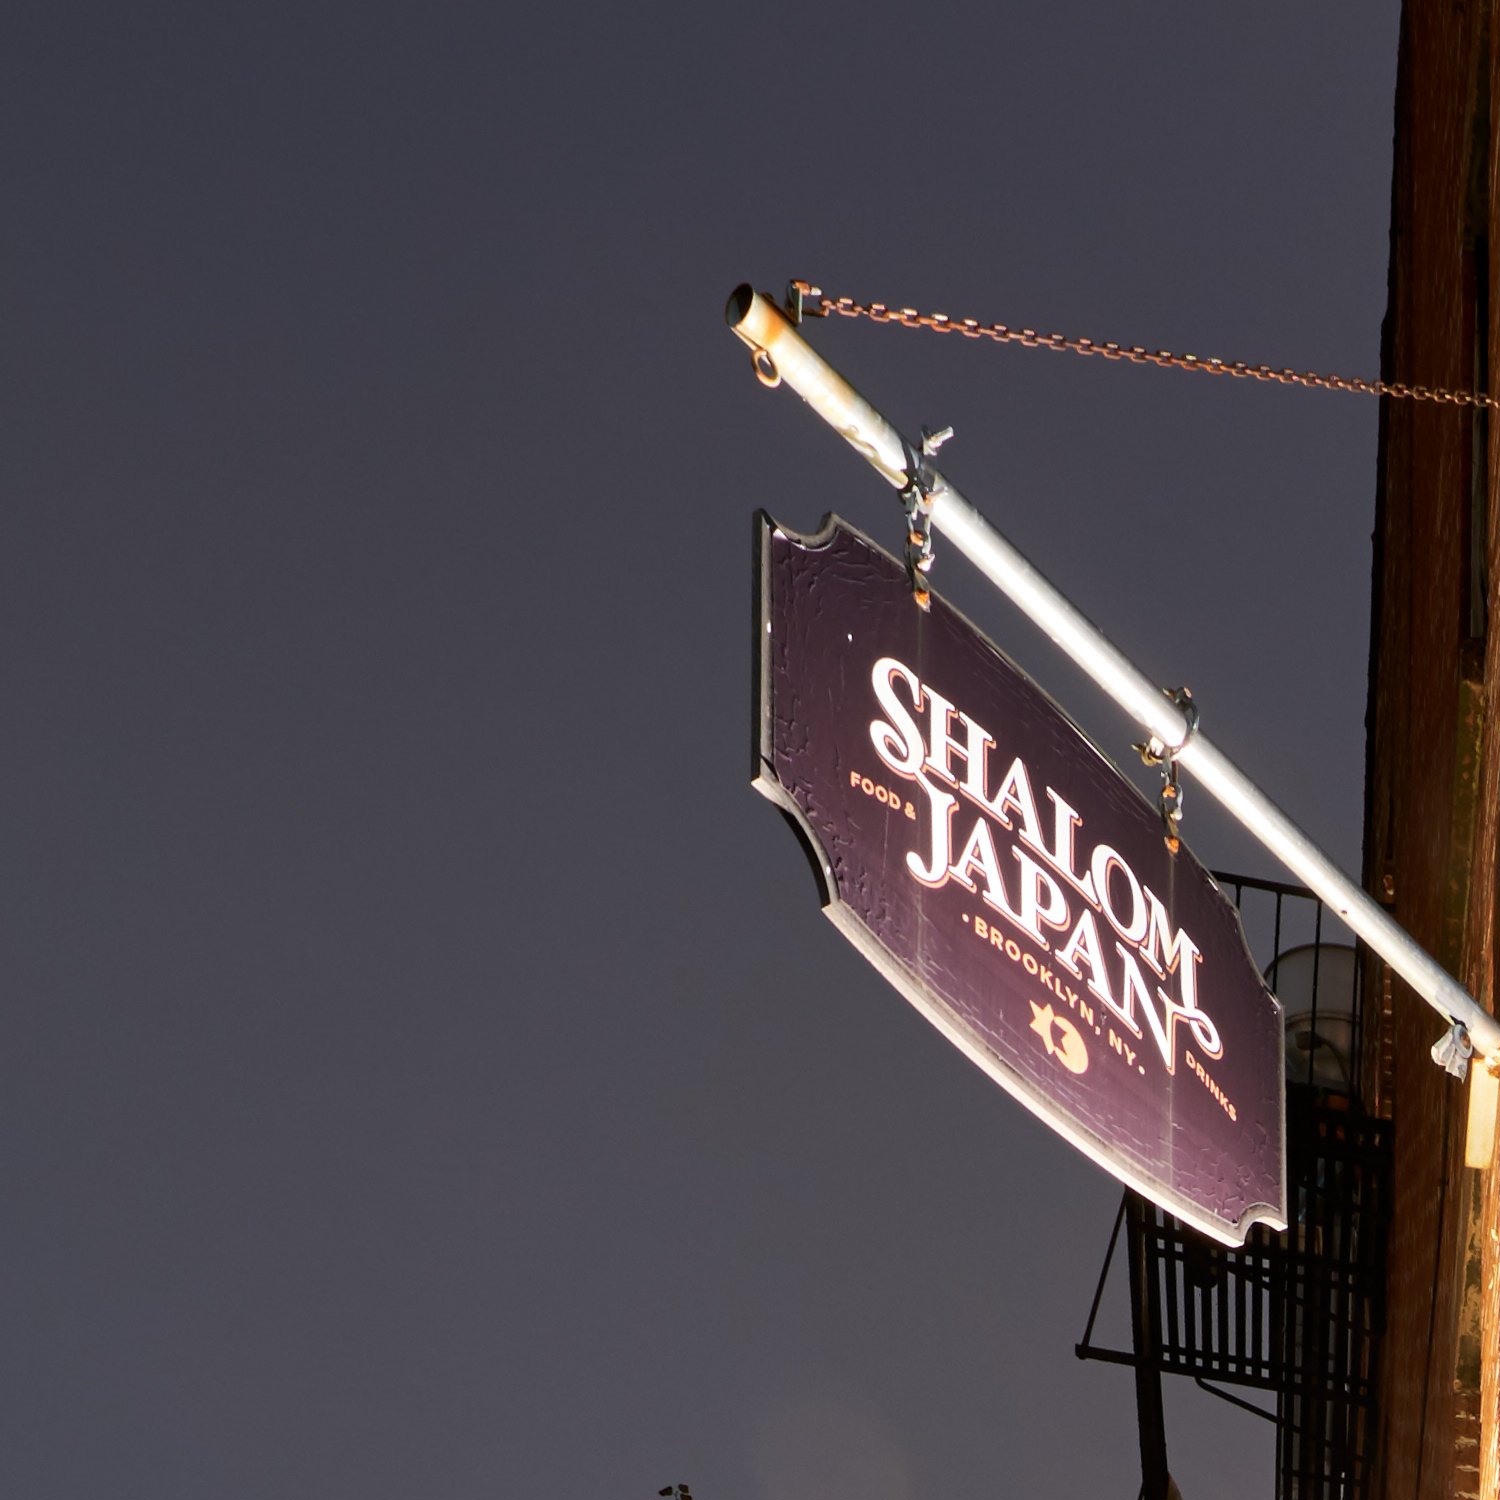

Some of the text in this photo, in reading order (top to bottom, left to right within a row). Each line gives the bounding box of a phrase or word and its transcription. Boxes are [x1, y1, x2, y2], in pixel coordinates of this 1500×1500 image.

[850, 771, 917, 821] FOOD &
[869, 656, 1224, 1061] SHALOM
[905, 772, 1186, 1075] JAPAN
[1185, 1049, 1238, 1122] DRINKS
